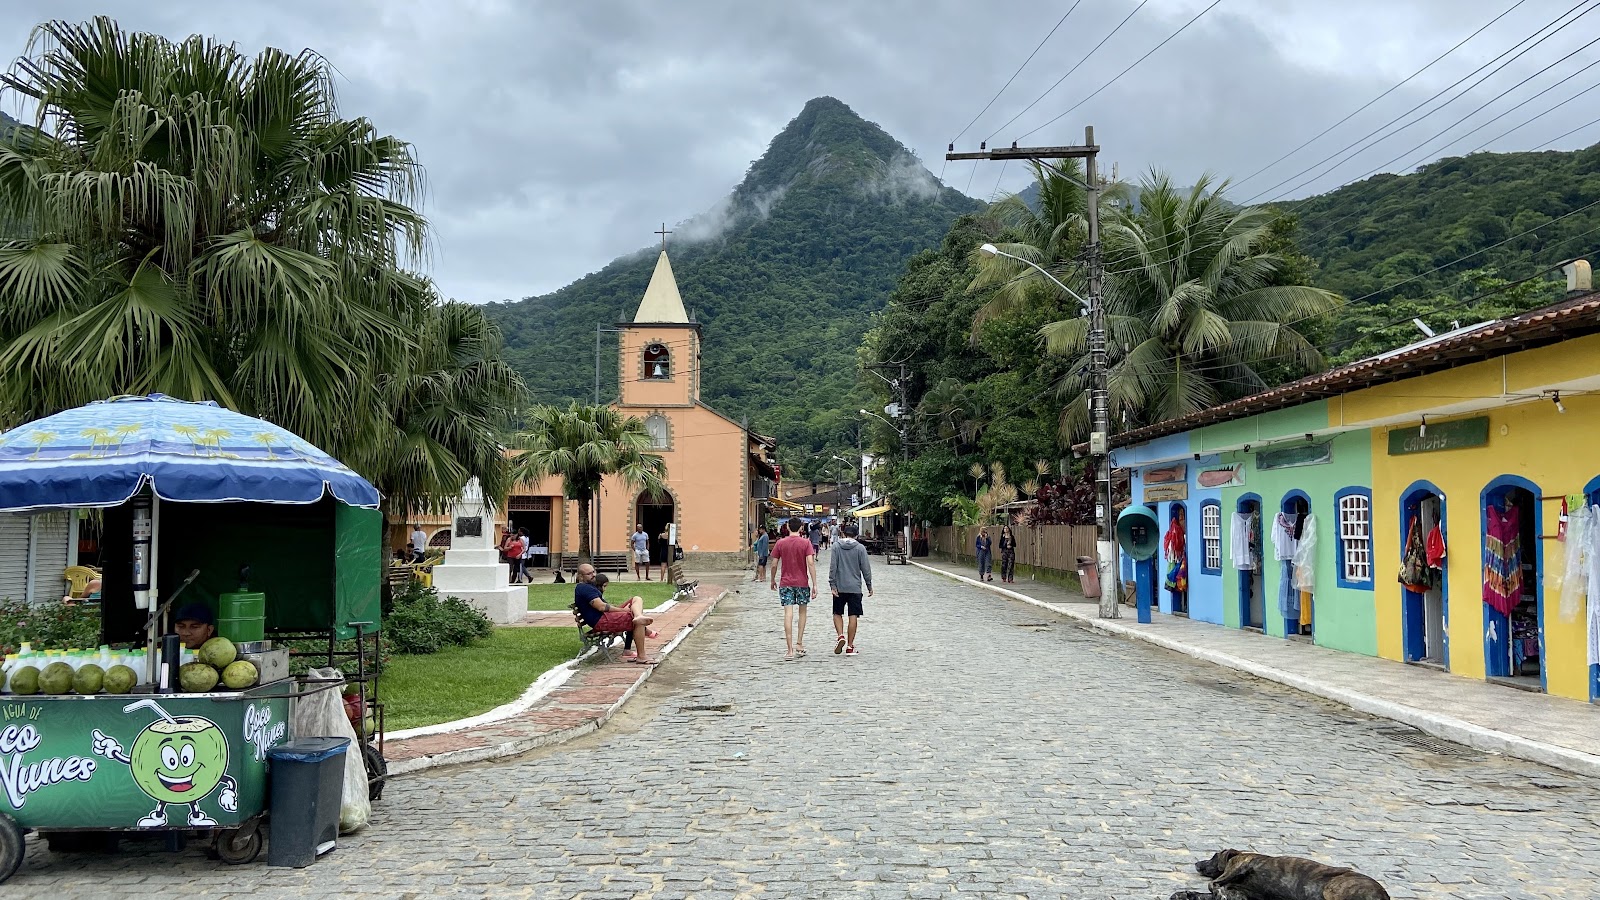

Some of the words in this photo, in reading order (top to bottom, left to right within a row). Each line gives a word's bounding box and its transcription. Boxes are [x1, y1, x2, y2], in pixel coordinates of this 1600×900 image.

[2, 703, 26, 721] ÁGUA
[29, 706, 43, 720] DE
[244, 704, 272, 743] Coco
[253, 721, 285, 762] Nunes
